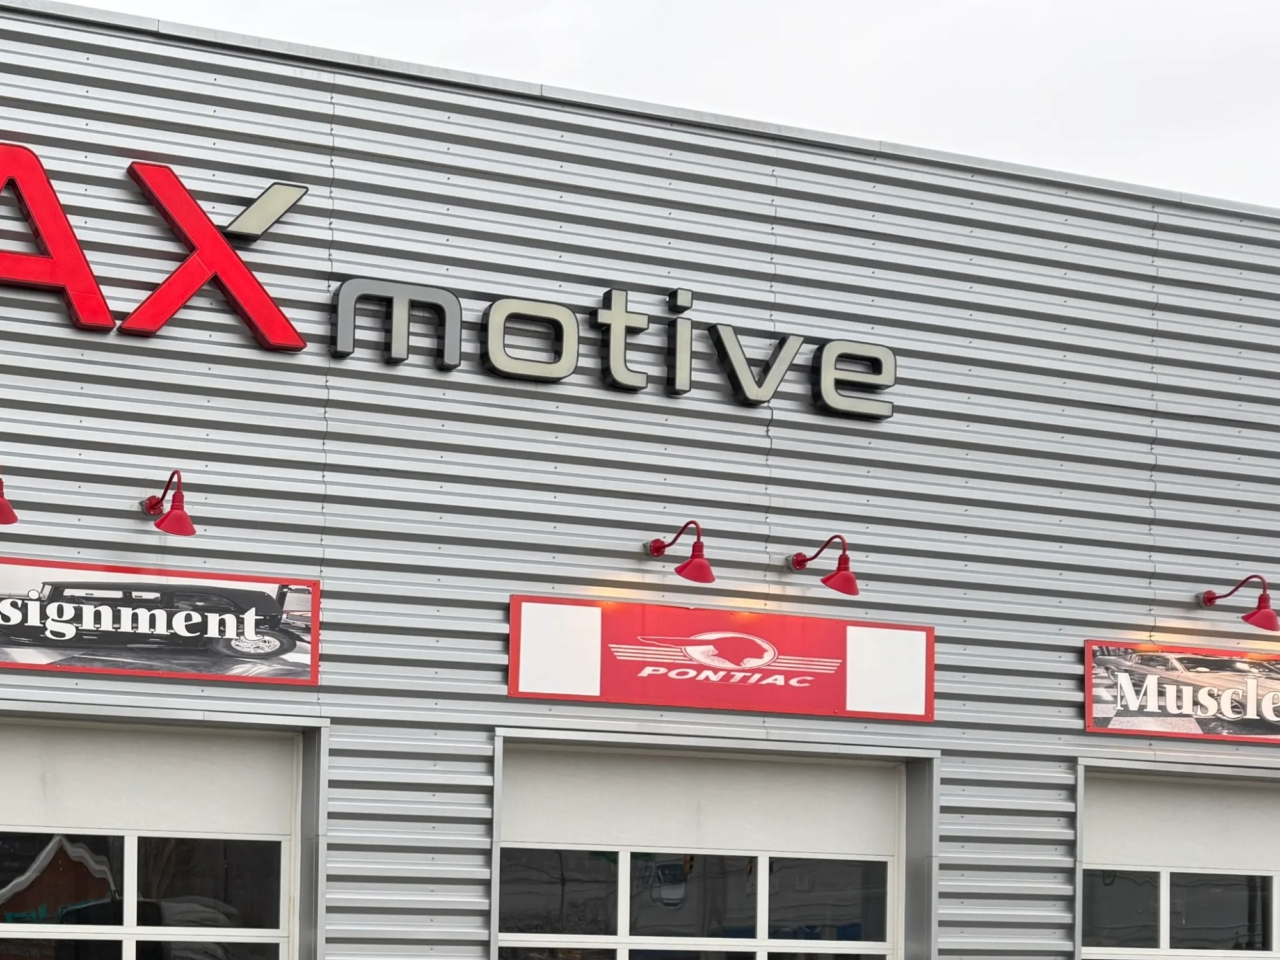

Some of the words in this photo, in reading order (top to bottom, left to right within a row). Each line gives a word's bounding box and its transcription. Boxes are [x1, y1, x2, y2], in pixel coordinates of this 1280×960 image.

[331, 277, 898, 421] motive
[637, 666, 814, 687] PONTIAC
[1115, 671, 1280, 722] Muscle
